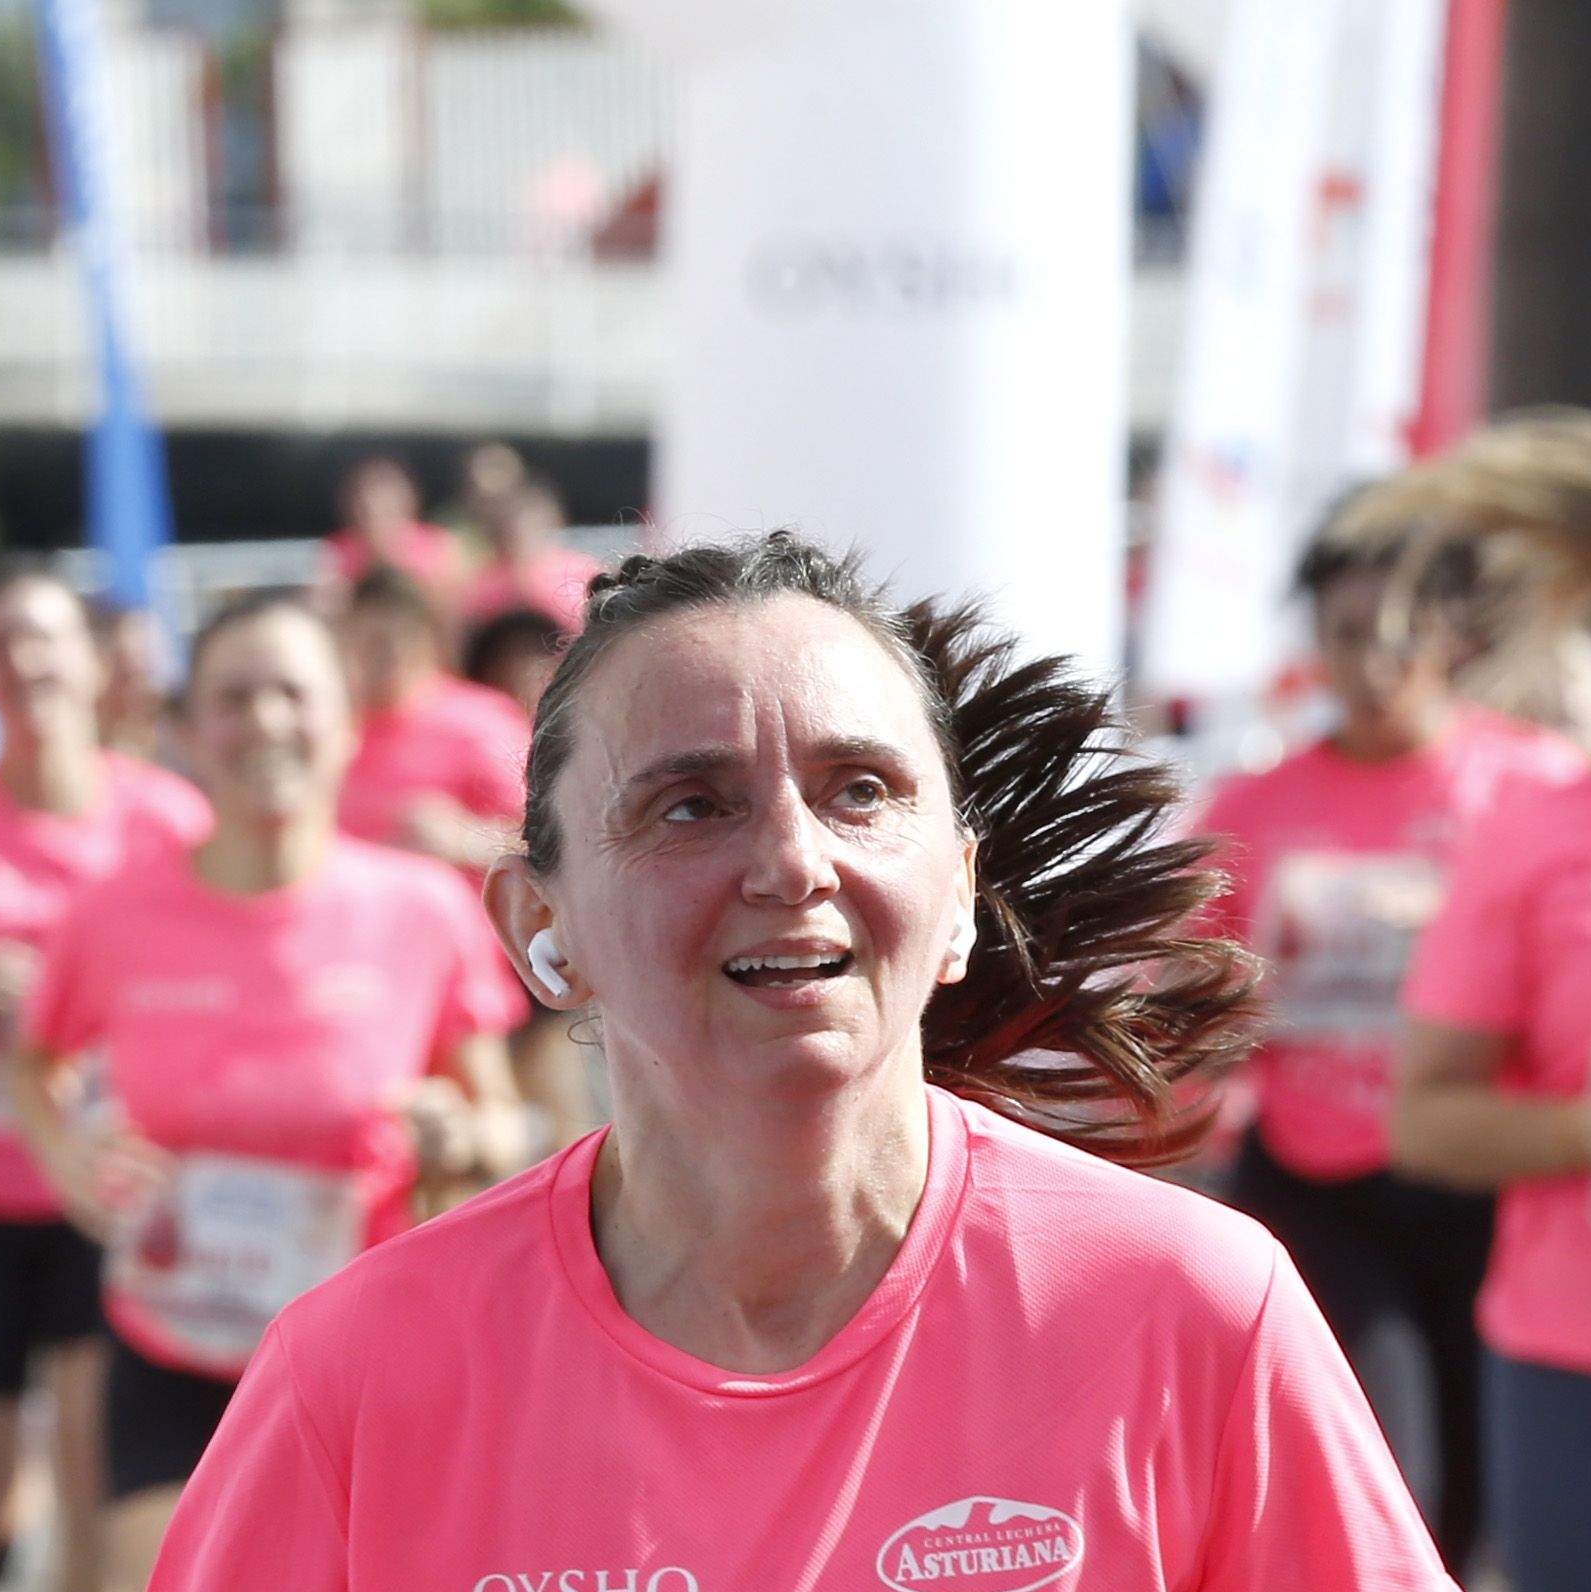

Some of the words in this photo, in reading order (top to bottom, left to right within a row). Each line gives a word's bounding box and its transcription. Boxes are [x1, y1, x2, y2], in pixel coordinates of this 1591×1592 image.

[924, 1532, 991, 1548] CENTRAL
[996, 1522, 1061, 1541] LECHERA
[895, 1537, 1071, 1582] ASTURIANA
